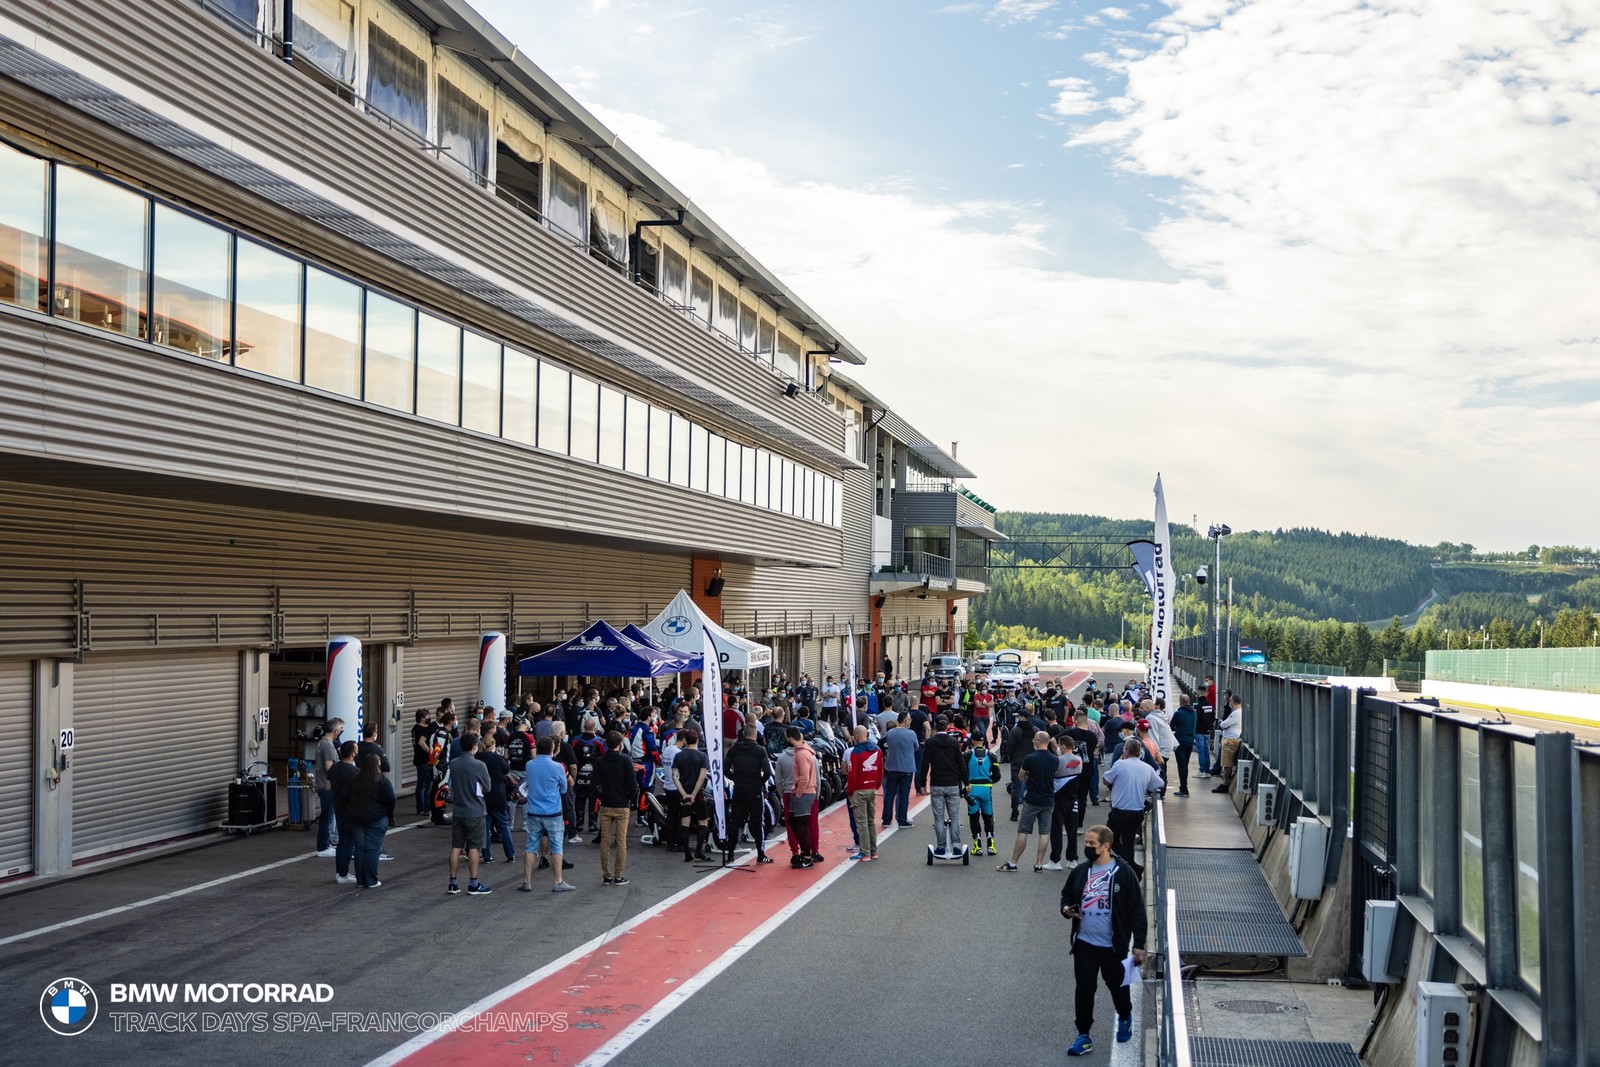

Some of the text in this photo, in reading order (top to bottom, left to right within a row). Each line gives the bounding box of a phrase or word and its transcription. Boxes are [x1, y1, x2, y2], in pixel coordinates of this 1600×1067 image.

[397, 693, 403, 705] 18
[260, 709, 268, 723] 19
[61, 730, 73, 747] 20
[1098, 899, 1110, 909] 63
